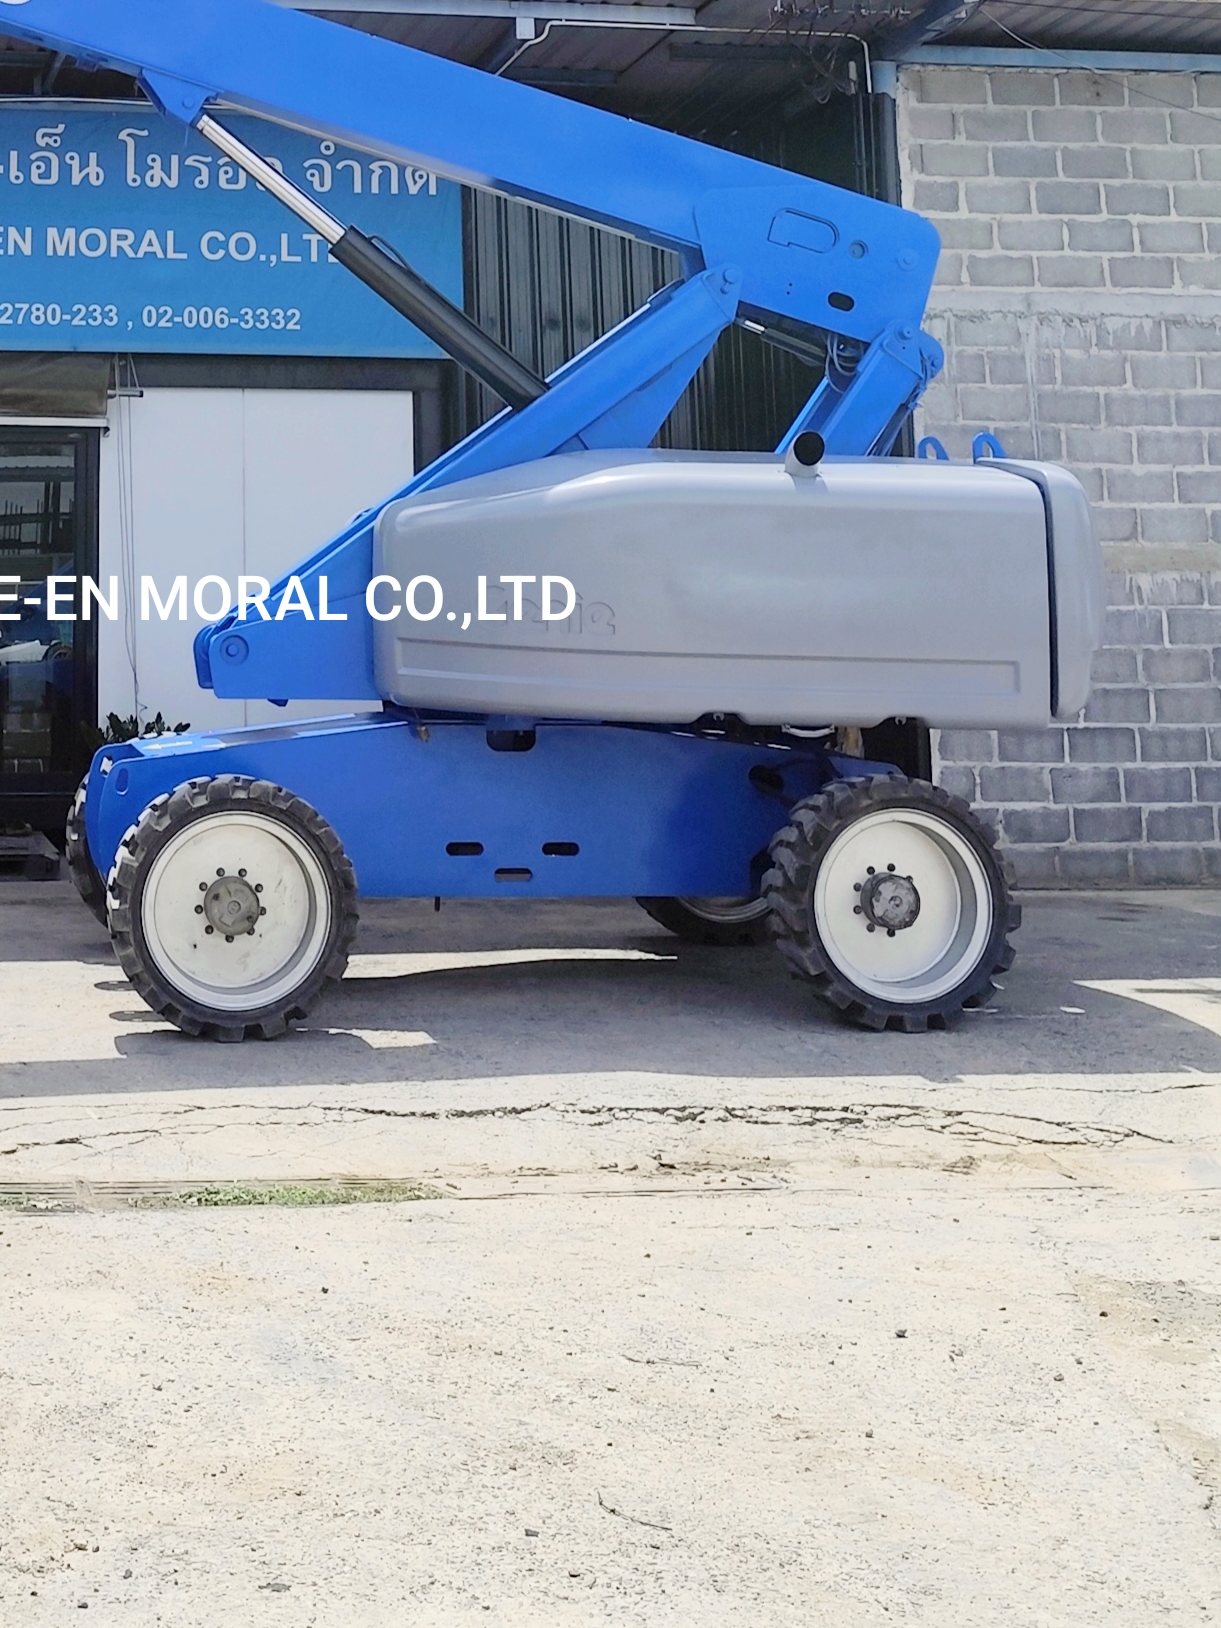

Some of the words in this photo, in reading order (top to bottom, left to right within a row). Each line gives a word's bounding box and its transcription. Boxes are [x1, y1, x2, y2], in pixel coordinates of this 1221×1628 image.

[302, 140, 437, 195] จำกด
[46, 227, 188, 261] MORAL
[200, 230, 338, 268] CO.,LT
[142, 305, 301, 330] 02-006-3332
